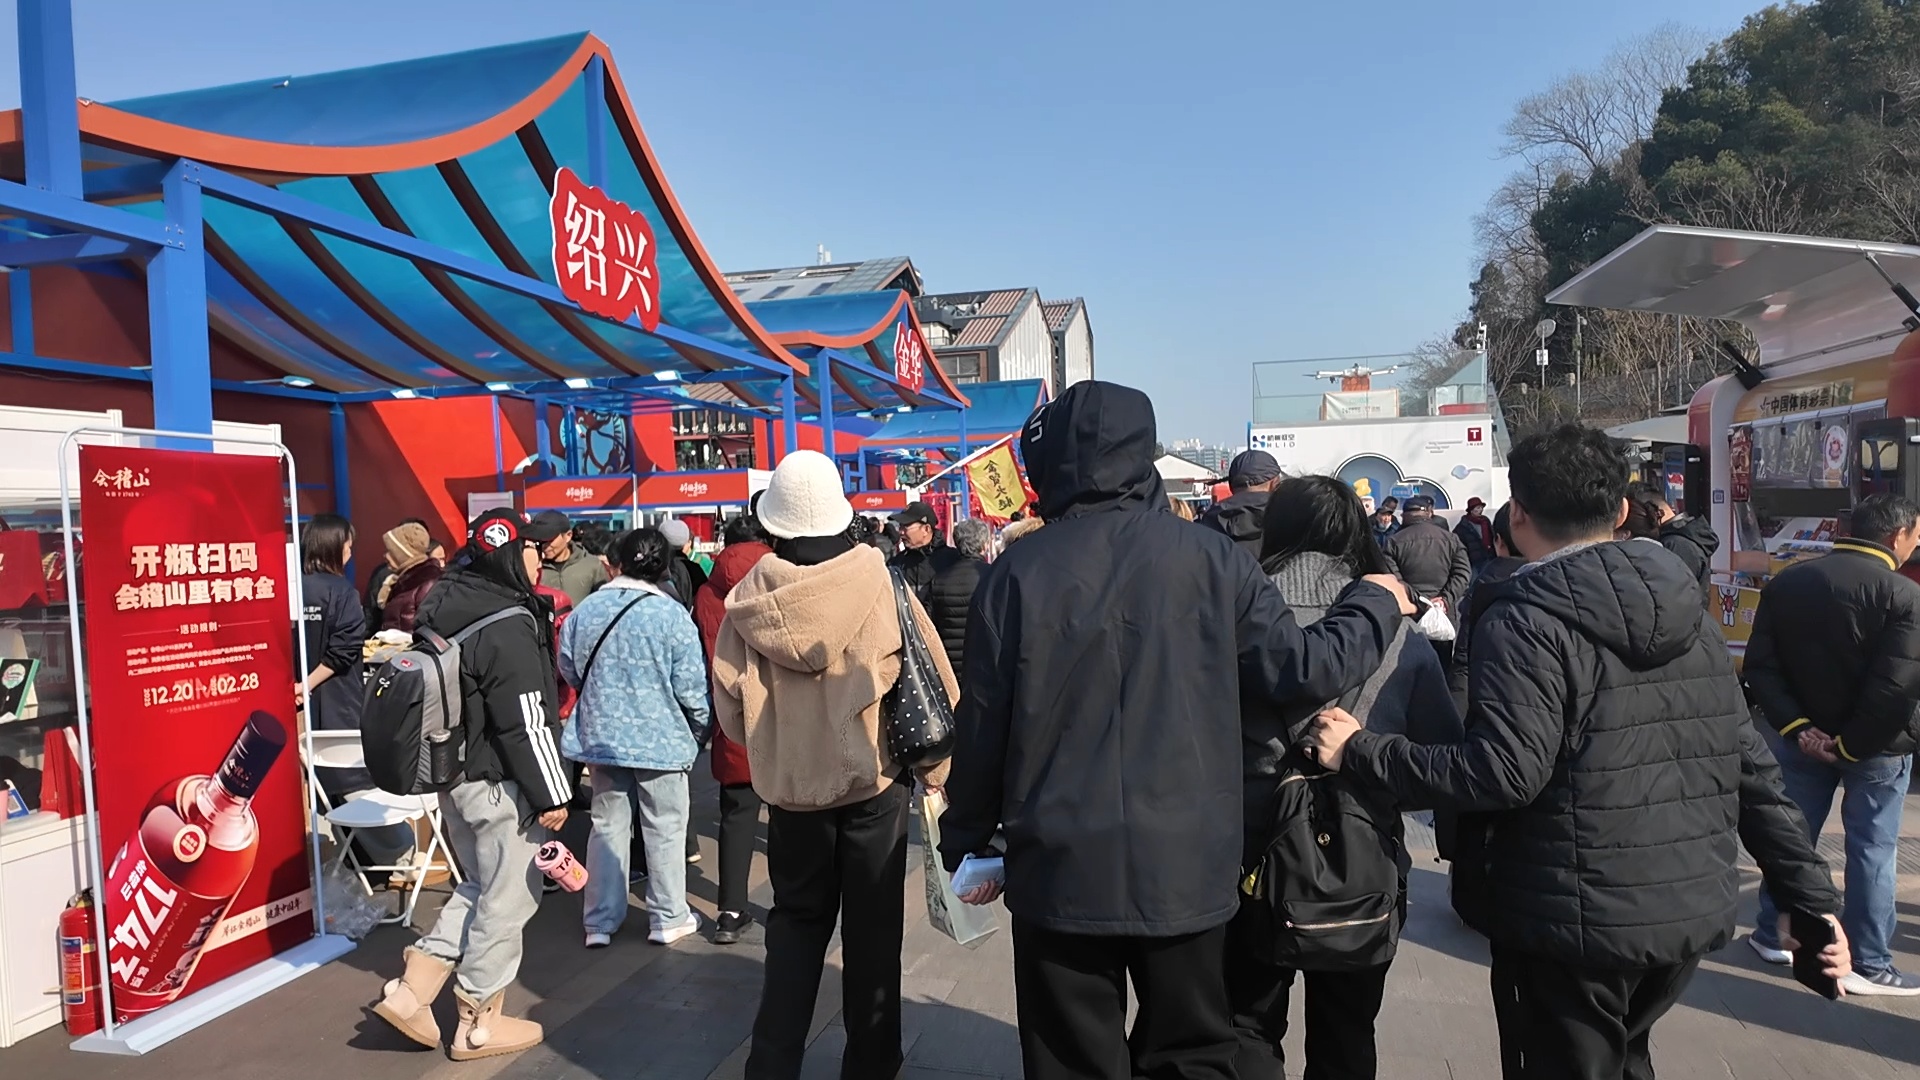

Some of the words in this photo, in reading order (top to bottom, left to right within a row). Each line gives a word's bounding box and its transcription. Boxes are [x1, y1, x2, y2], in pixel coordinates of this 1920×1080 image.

[564, 190, 652, 313] 绍兴
[898, 332, 922, 385] 金华
[1770, 386, 1830, 414] 中国体育彩票
[1470, 429, 1479, 439] T
[92, 466, 150, 490] 会稽山
[131, 542, 258, 579] 开瓶扫码
[115, 576, 275, 611] 会稽山里有黄金
[180, 622, 217, 634] 活动规则
[151, 682, 193, 705] 12.20
[217, 672, 260, 695] 02.28
